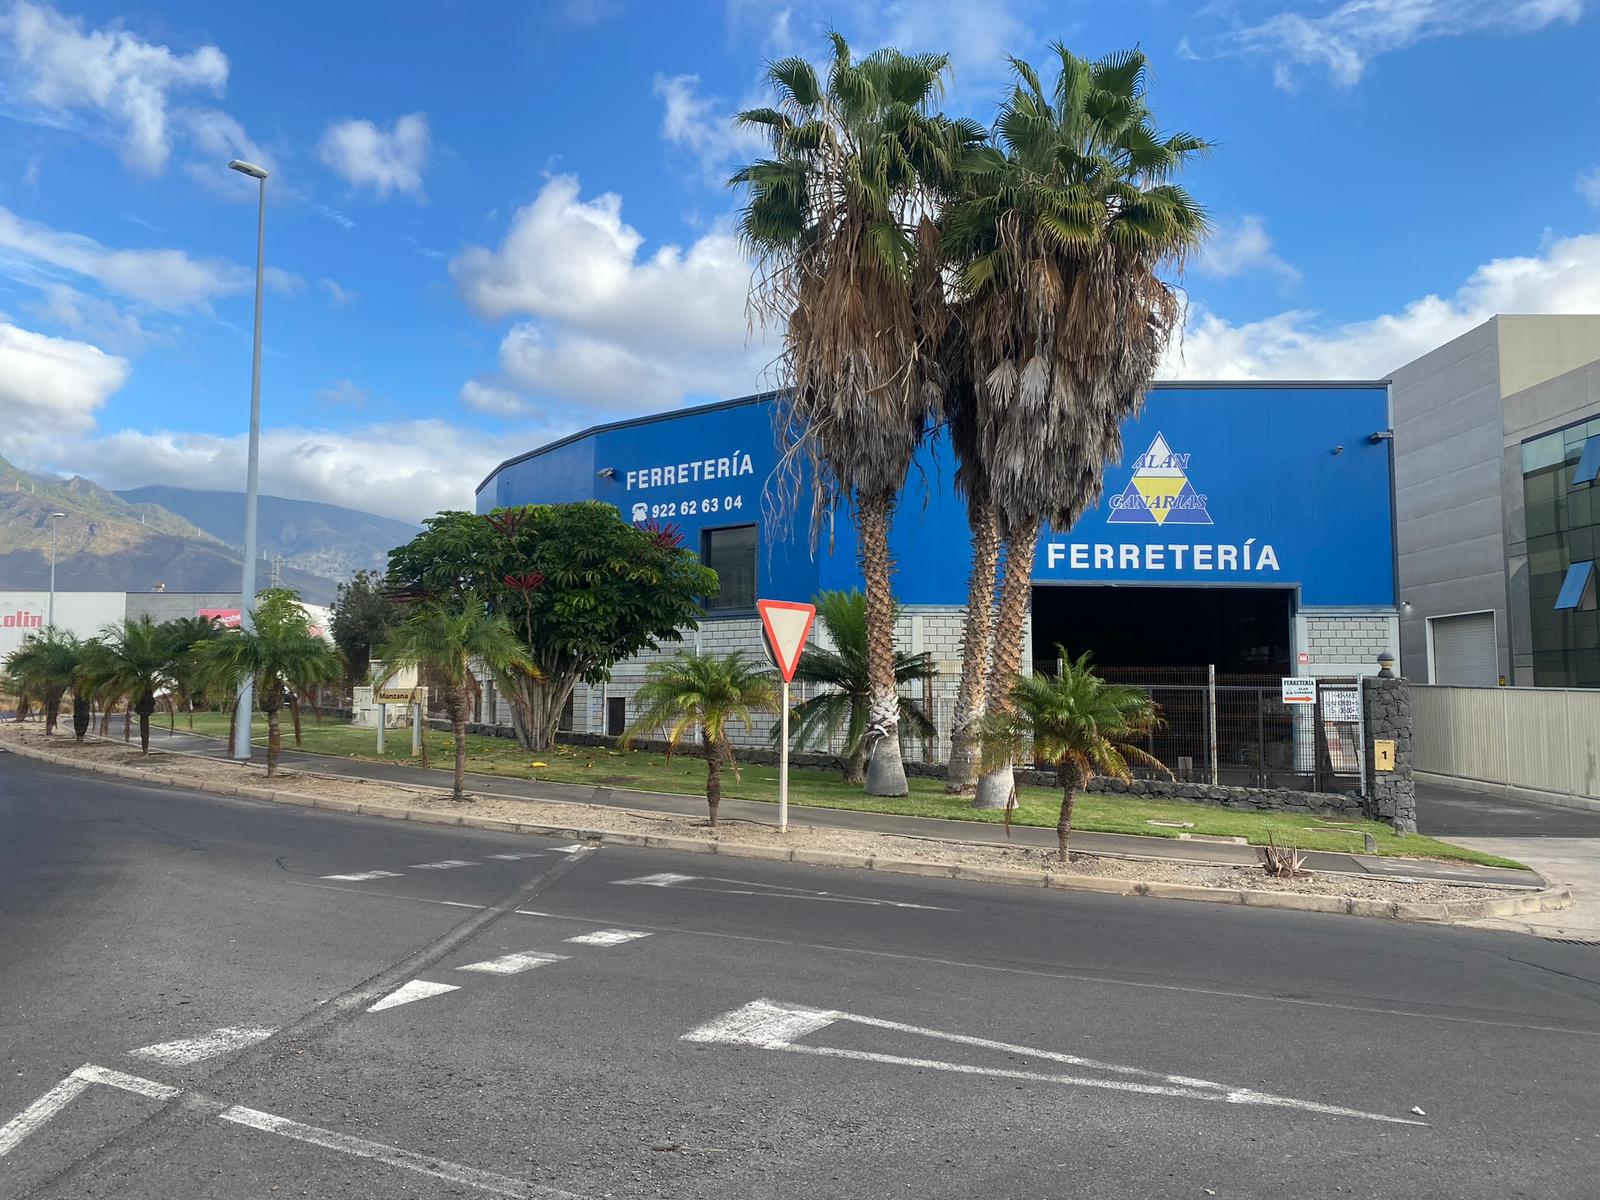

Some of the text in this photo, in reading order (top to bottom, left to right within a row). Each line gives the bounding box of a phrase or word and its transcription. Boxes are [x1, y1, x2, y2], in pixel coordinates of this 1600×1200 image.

[1132, 453, 1191, 469] ALAN
[626, 450, 753, 491] FERRETERÍA
[652, 495, 743, 519] 922 62 63 04
[1109, 494, 1208, 510] CANARIAS
[1047, 538, 1280, 571] FERRETERÍA
[0, 611, 42, 627] olin
[1381, 750, 1388, 760] 1
